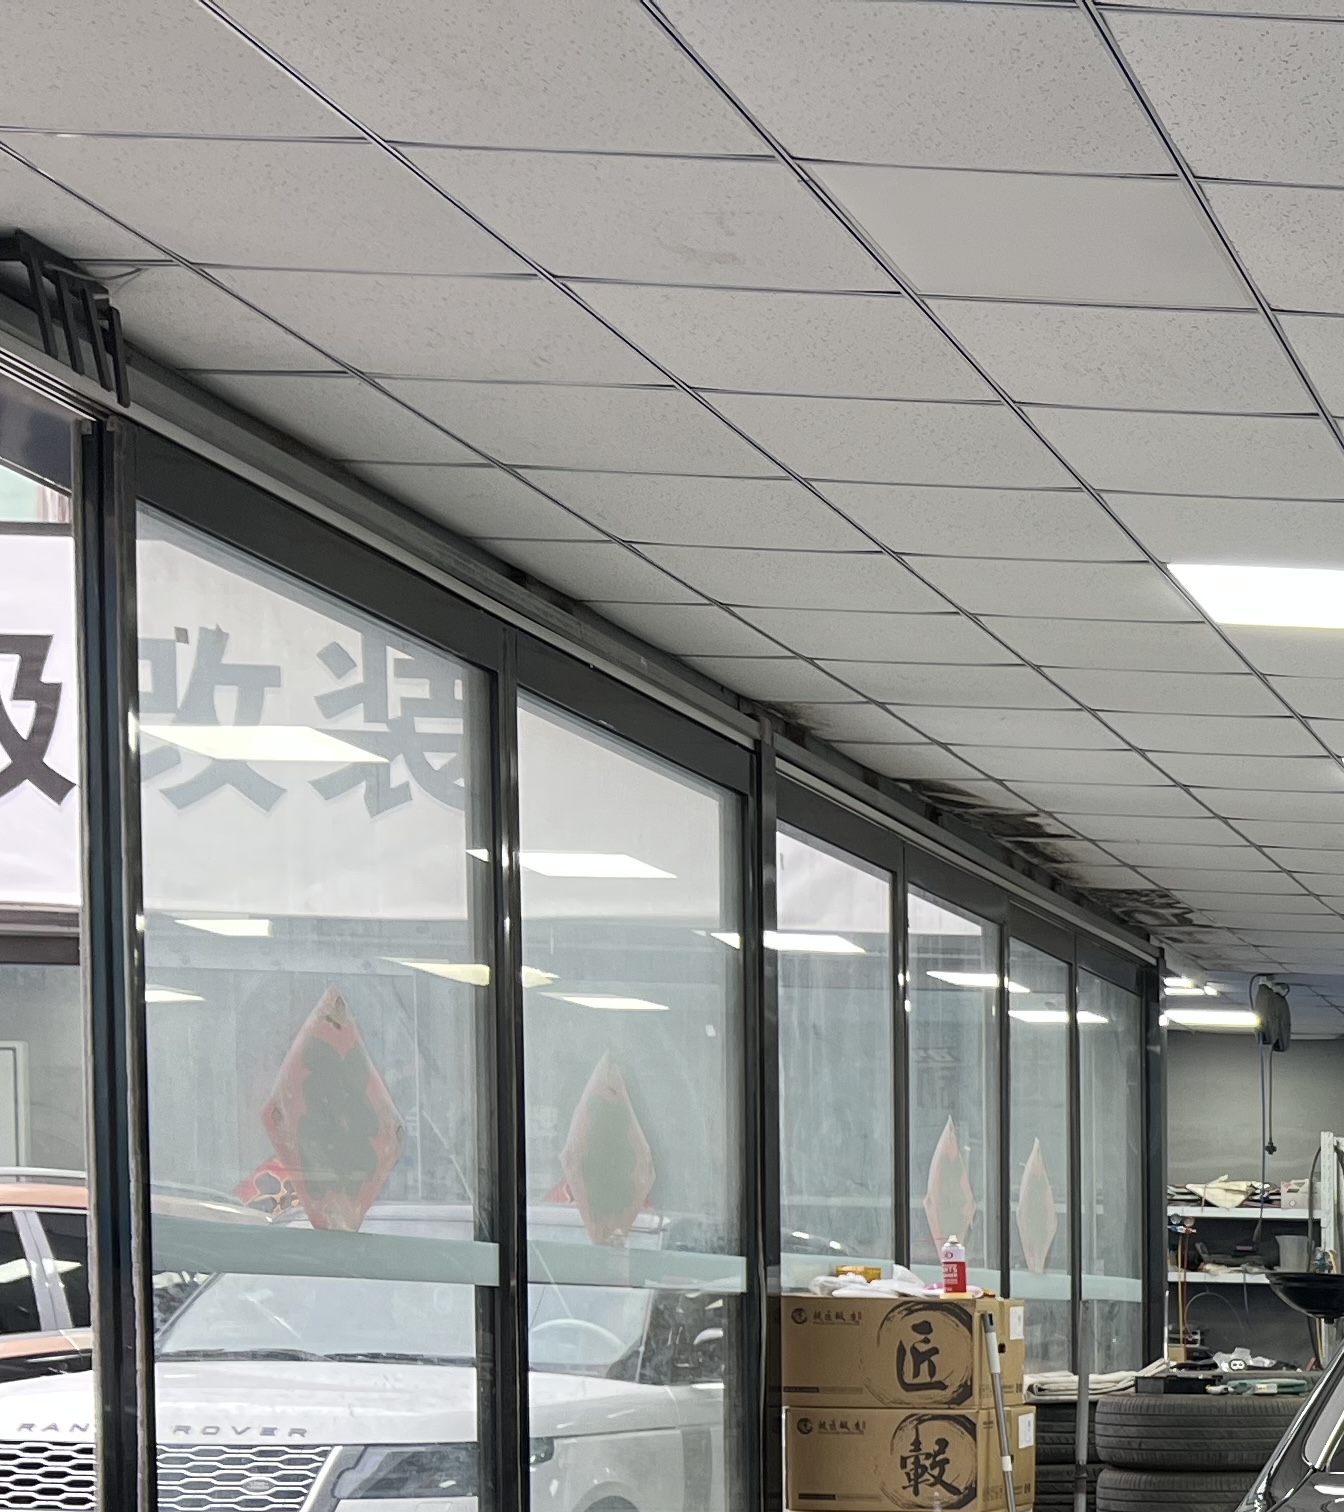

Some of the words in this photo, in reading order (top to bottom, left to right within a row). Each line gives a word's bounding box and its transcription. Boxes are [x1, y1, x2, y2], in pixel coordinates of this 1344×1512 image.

[896, 1320, 947, 1391] 匠
[17, 1423, 90, 1432] RAN
[172, 1424, 308, 1437] ROVER
